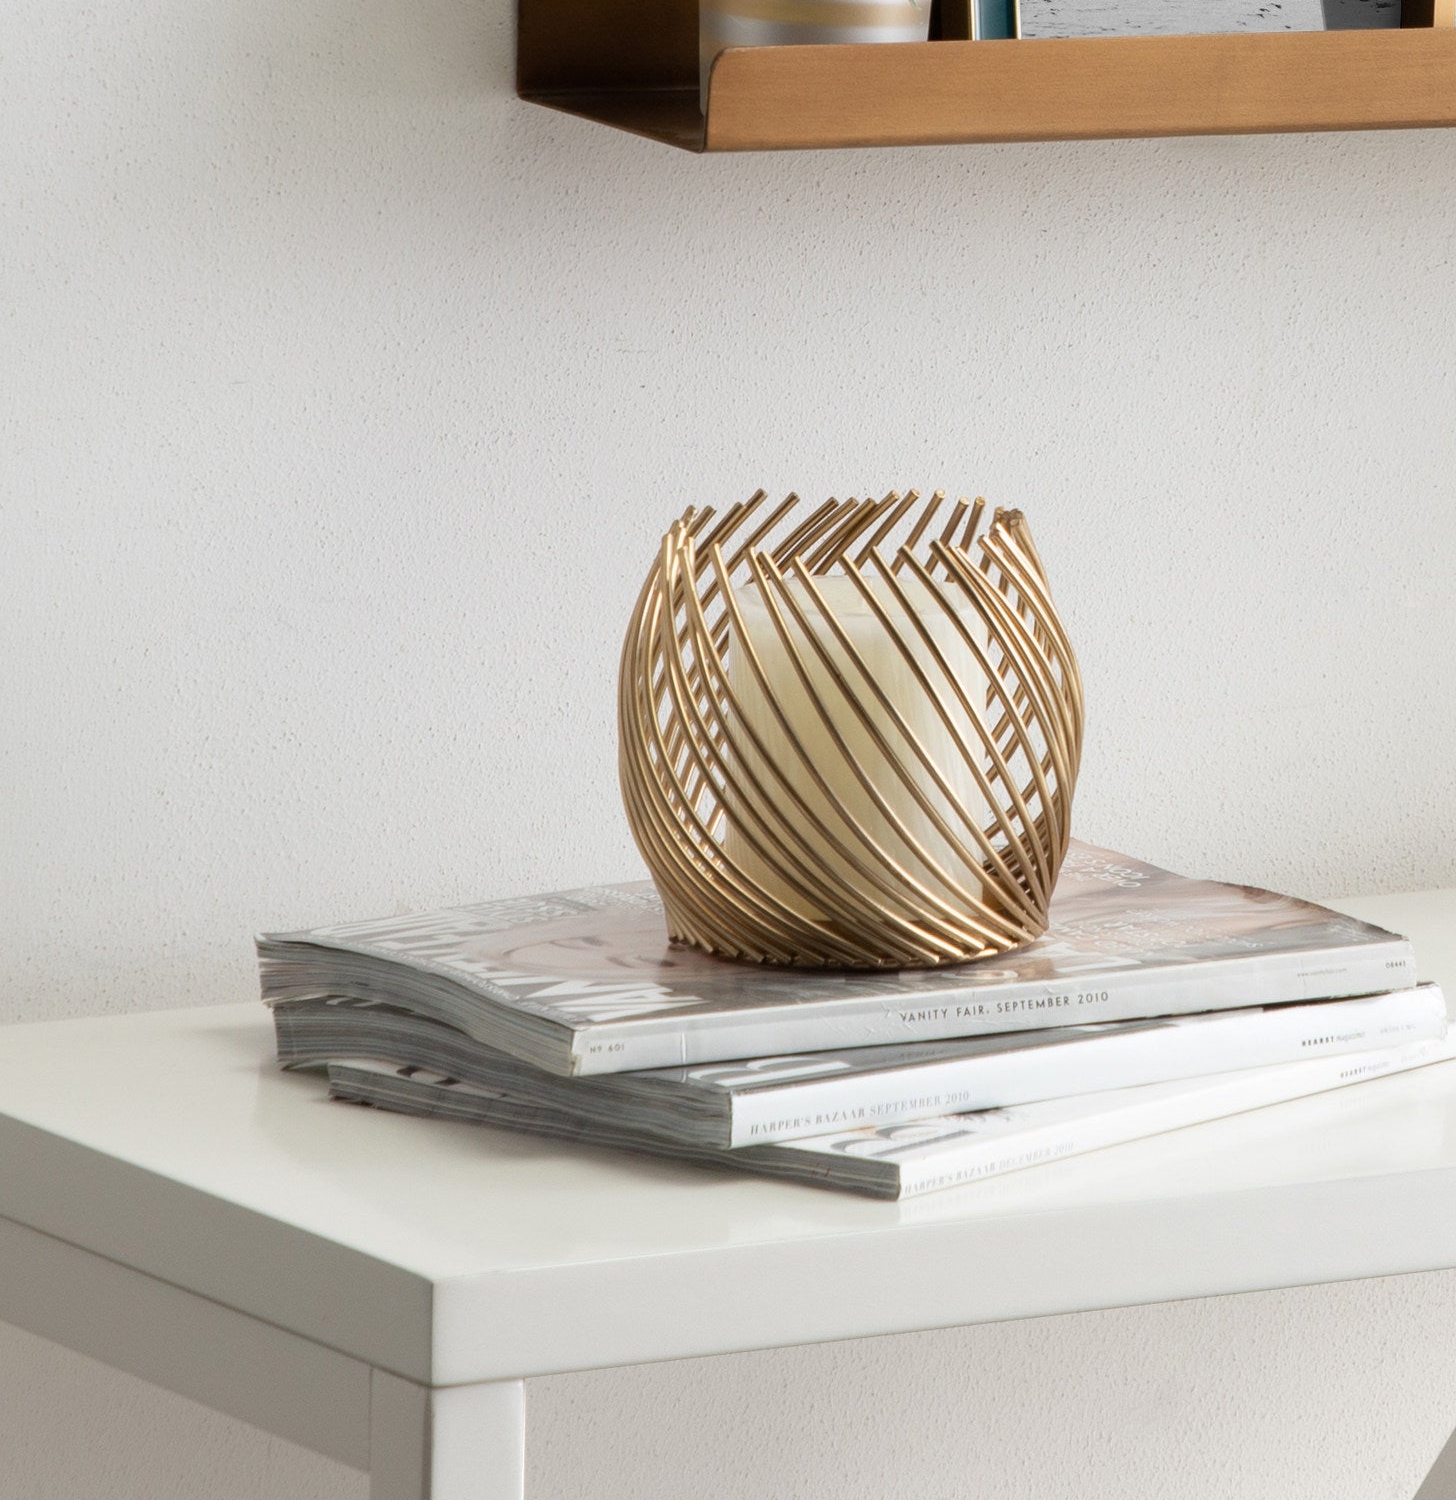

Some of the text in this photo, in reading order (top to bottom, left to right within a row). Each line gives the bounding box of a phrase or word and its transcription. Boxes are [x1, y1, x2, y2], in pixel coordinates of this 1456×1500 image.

[900, 1008, 949, 1023] VANITY
[996, 996, 1071, 1014] SEPTEMBER
[1077, 991, 1109, 1005] 2010
[1301, 1035, 1334, 1047] HEARST
[750, 1091, 970, 1136] HARPER'S BAZAAR SEPTEMBER 2010
[904, 1173, 954, 1194] HARPER'S
[956, 1162, 996, 1180] BAZAAR
[999, 1150, 1051, 1169] DECEMBER
